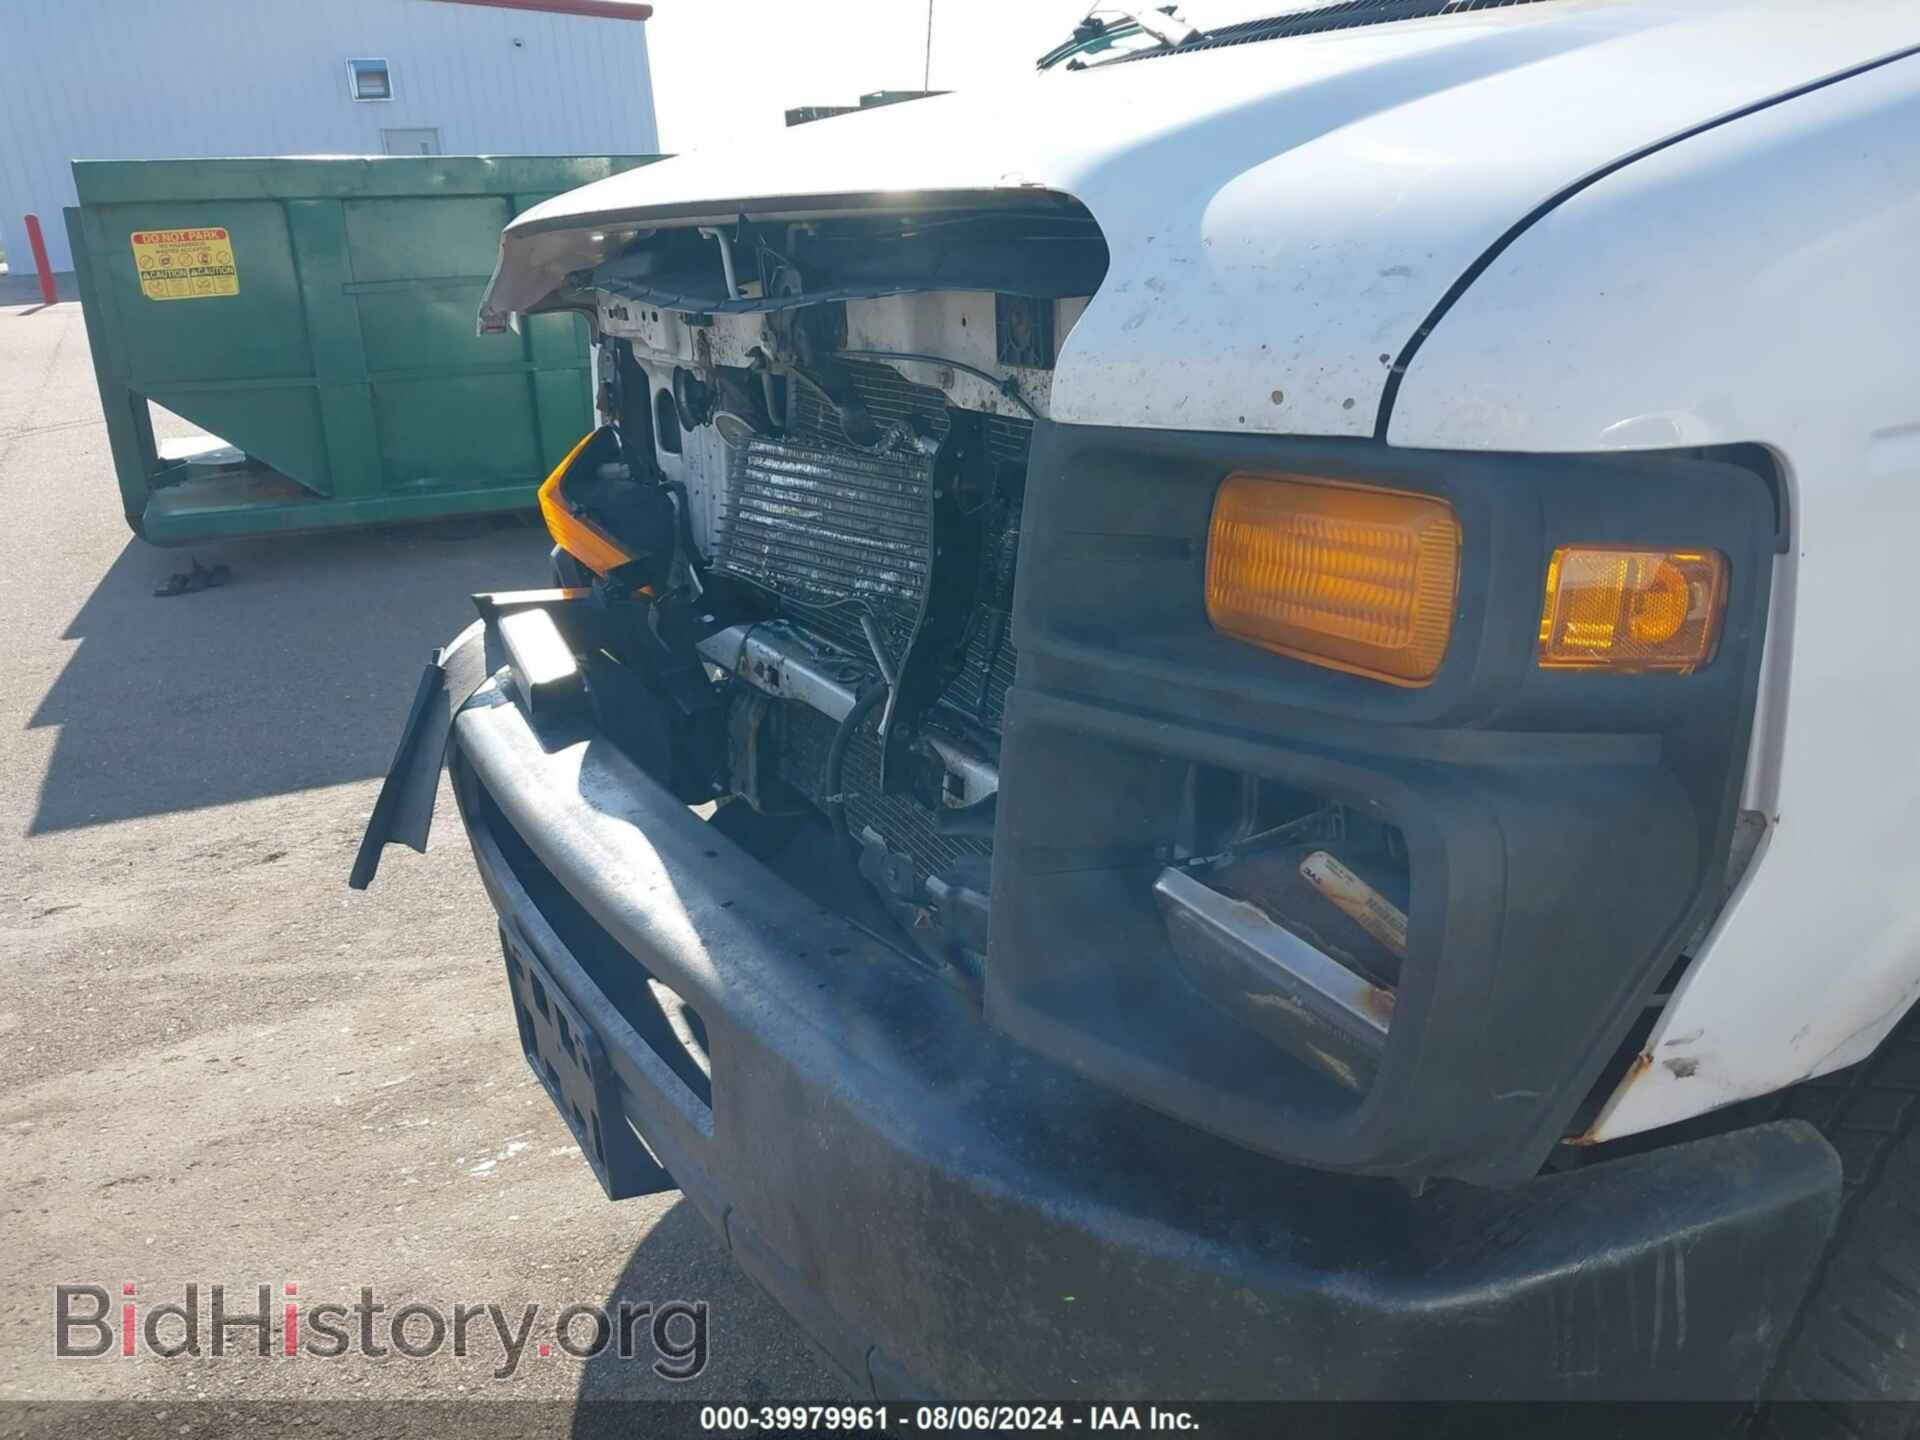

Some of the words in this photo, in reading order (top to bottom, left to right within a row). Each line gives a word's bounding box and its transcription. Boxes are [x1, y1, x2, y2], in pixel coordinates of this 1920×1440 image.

[143, 235, 160, 243] DO
[161, 233, 185, 242] NOT
[188, 231, 220, 241] PARK
